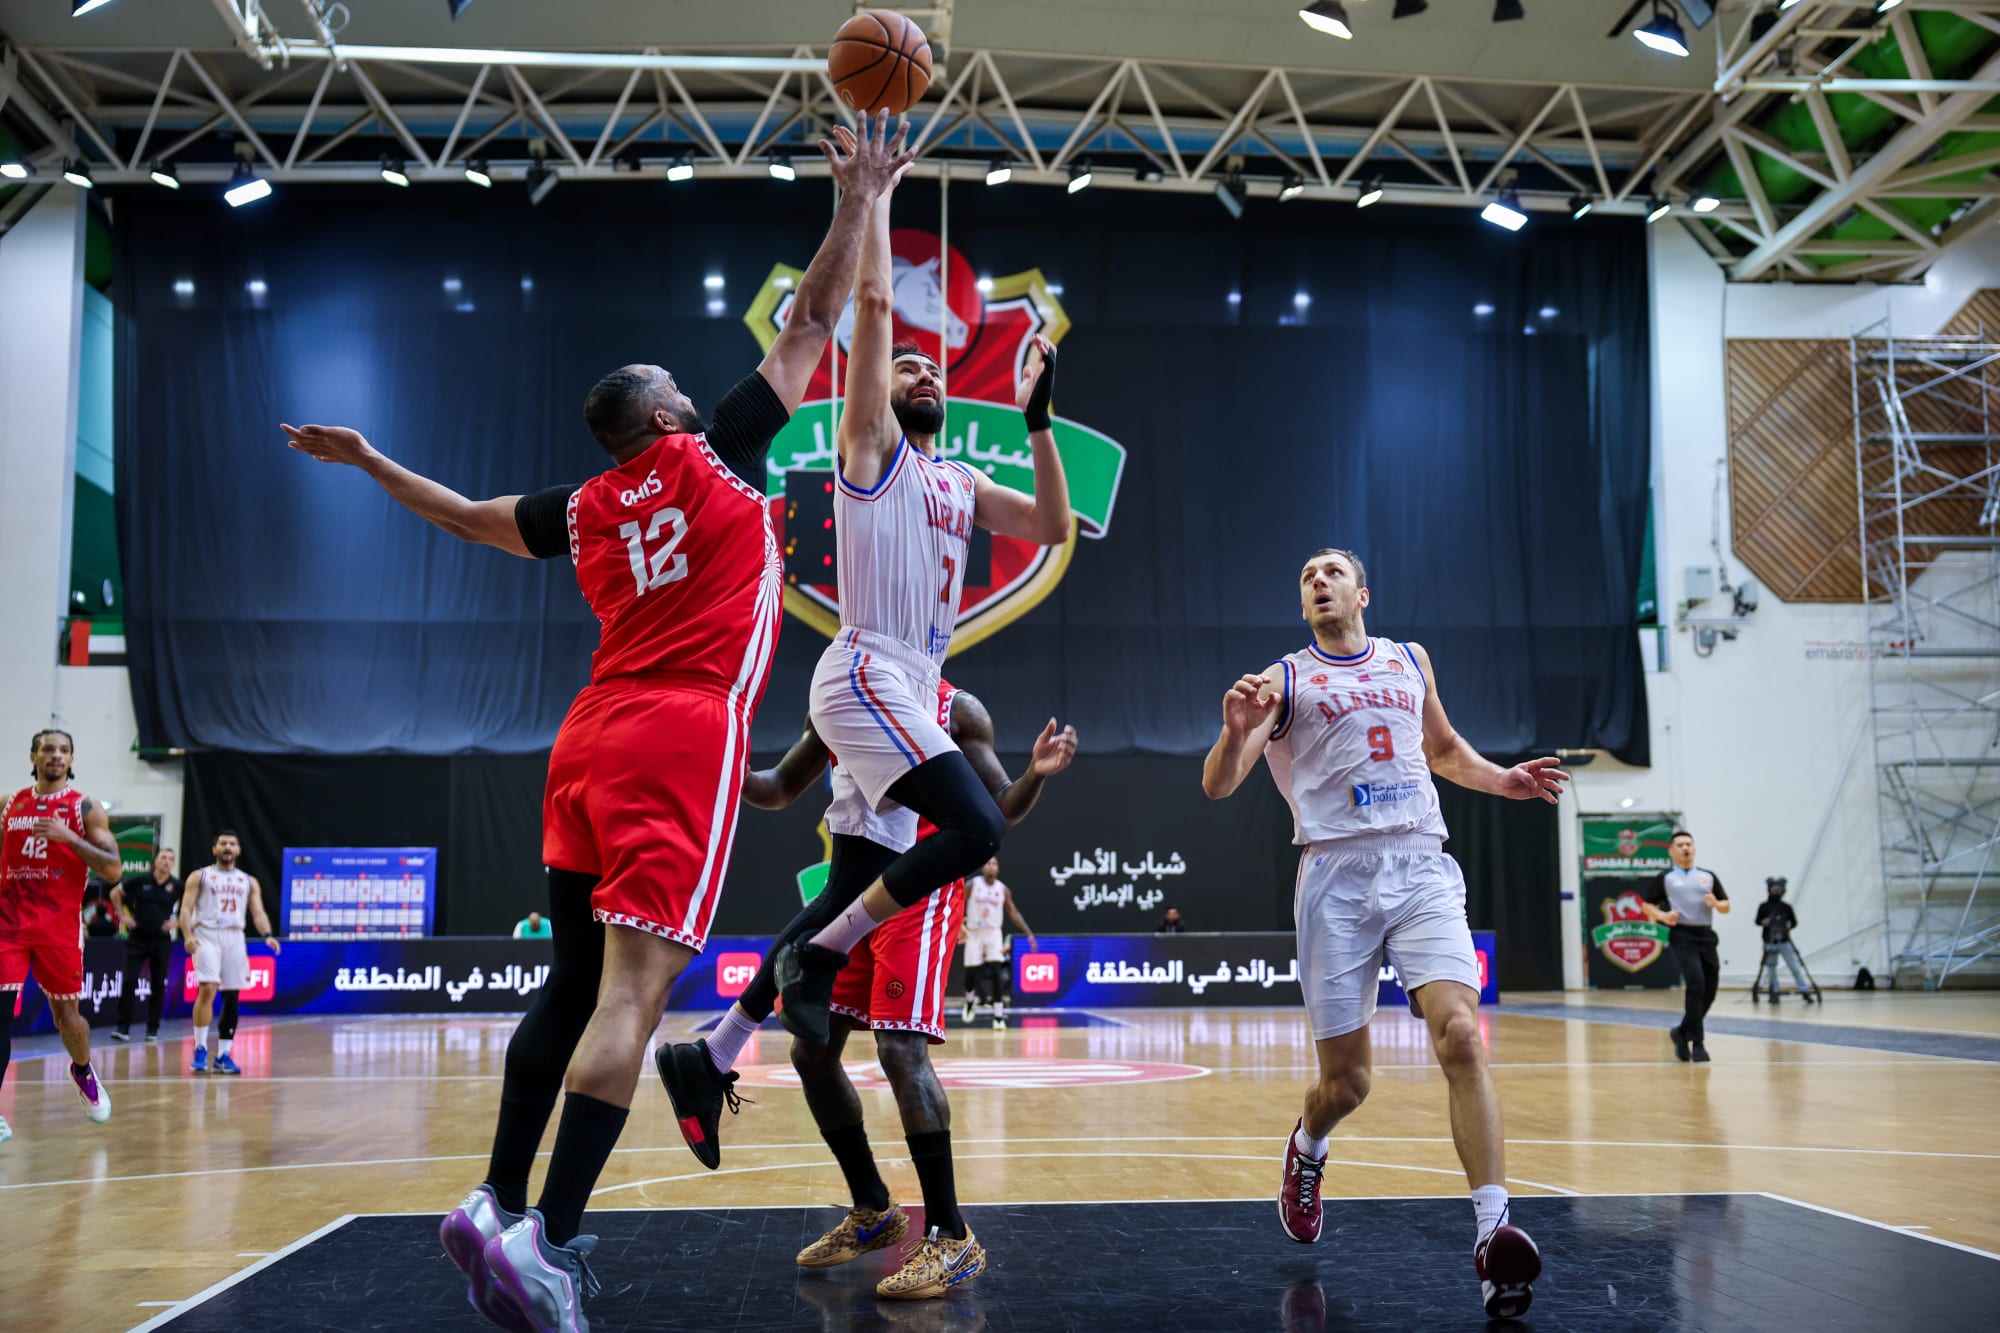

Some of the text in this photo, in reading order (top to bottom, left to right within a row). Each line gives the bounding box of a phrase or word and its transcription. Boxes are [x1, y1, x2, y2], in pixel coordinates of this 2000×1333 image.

[618, 507, 689, 597] 12
[940, 555, 956, 603] 7
[1317, 687, 1416, 724] ALARABI
[1366, 725, 1395, 762] 9
[1373, 793, 1398, 803] DOHA
[21, 836, 49, 859] 42
[1050, 847, 1186, 886] شباب الأهلي
[220, 899, 237, 913] 73
[1136, 888, 1164, 911] دبي
[250, 969, 269, 988] FI
[334, 963, 551, 1002] الرائد في المنطقة
[722, 965, 756, 985] CFI
[1025, 964, 1055, 981] CFI
[1085, 959, 1183, 984] المنطقة
[1187, 960, 1232, 995] في
